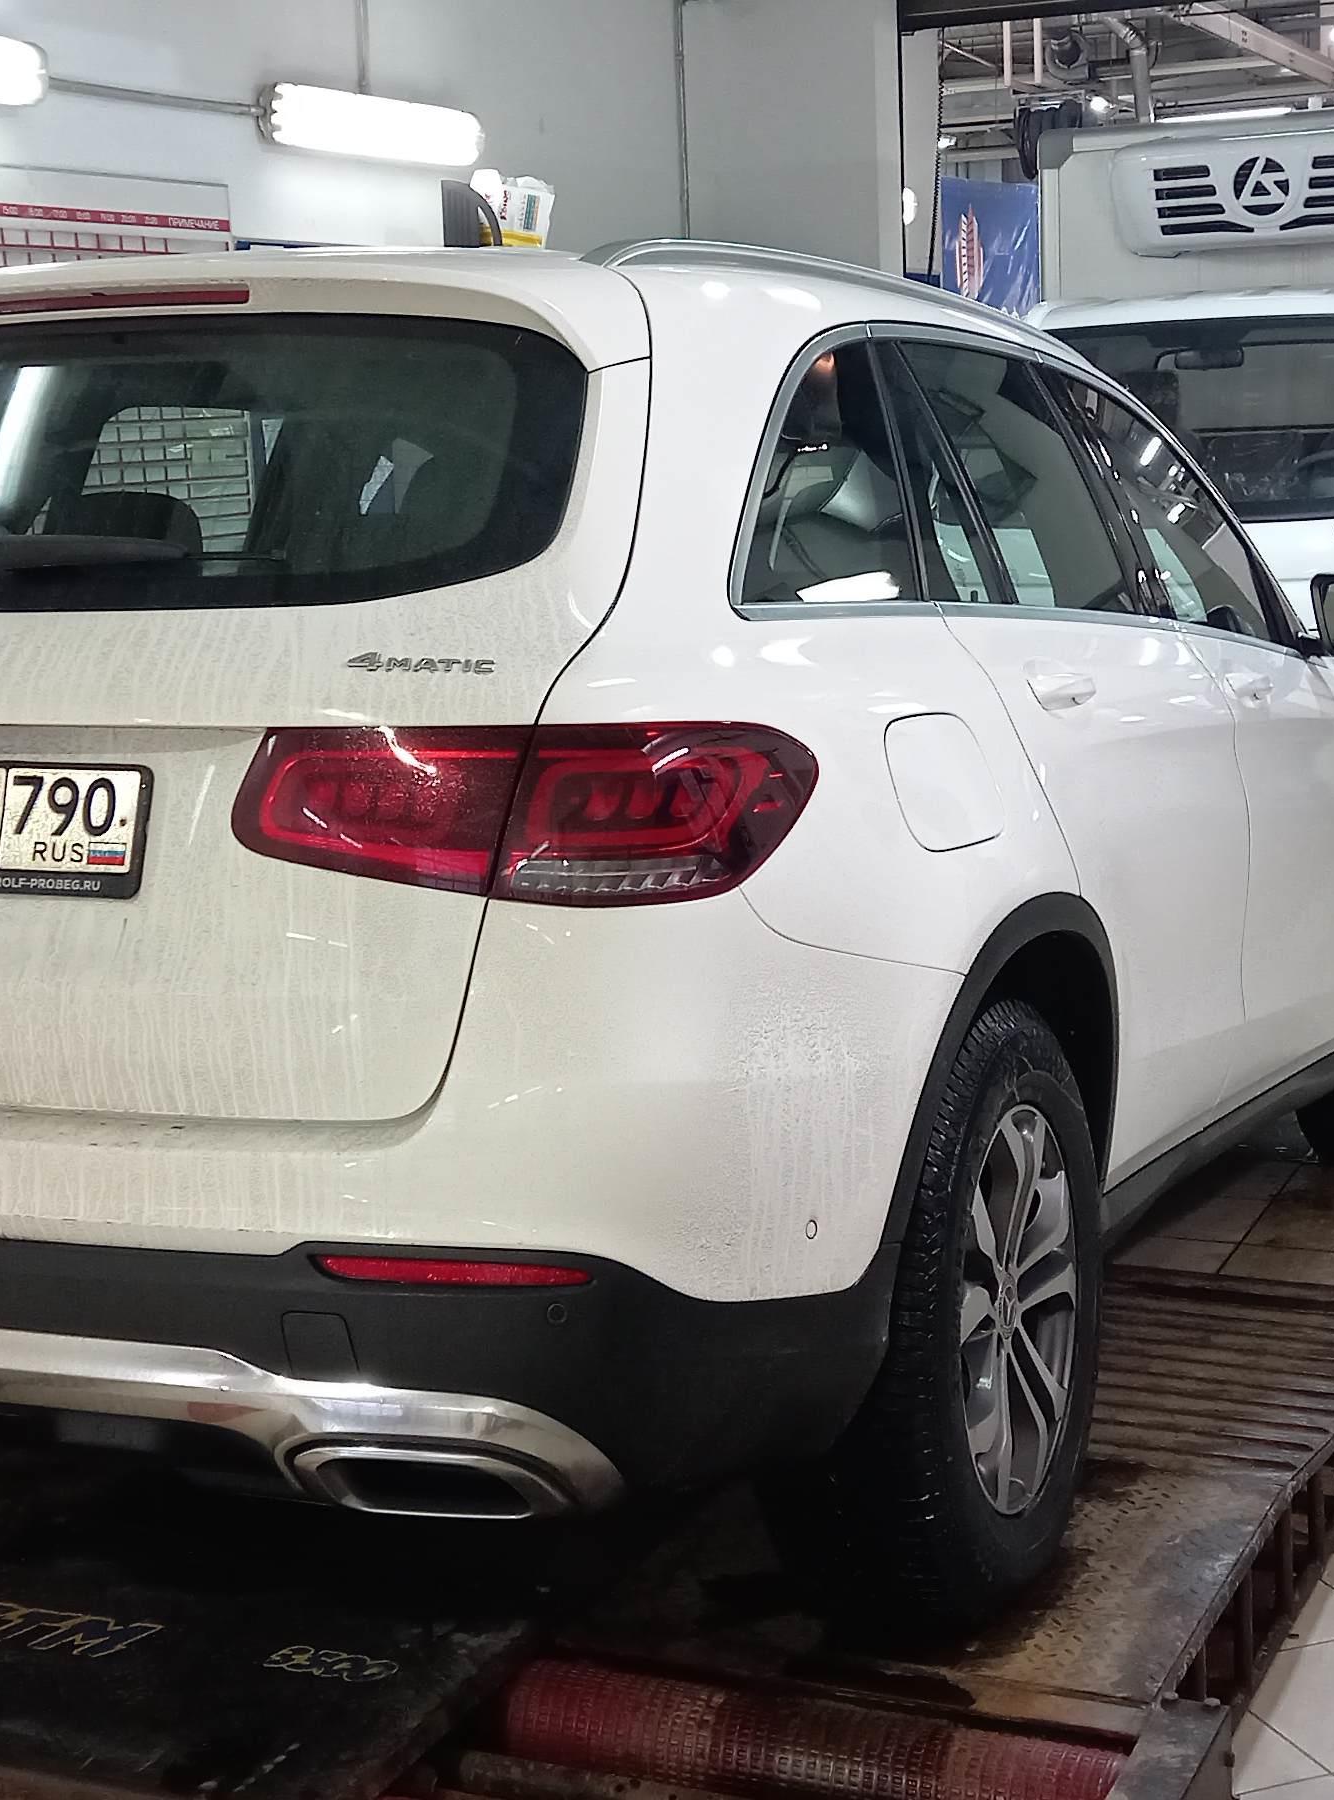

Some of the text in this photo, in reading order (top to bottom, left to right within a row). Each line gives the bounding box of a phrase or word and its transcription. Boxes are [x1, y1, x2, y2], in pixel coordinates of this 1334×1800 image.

[168, 217, 220, 230] ПРИМЕЧАНИЕ
[347, 651, 496, 675] 4MATIC
[12, 775, 117, 837] 790
[31, 841, 85, 863] RUS
